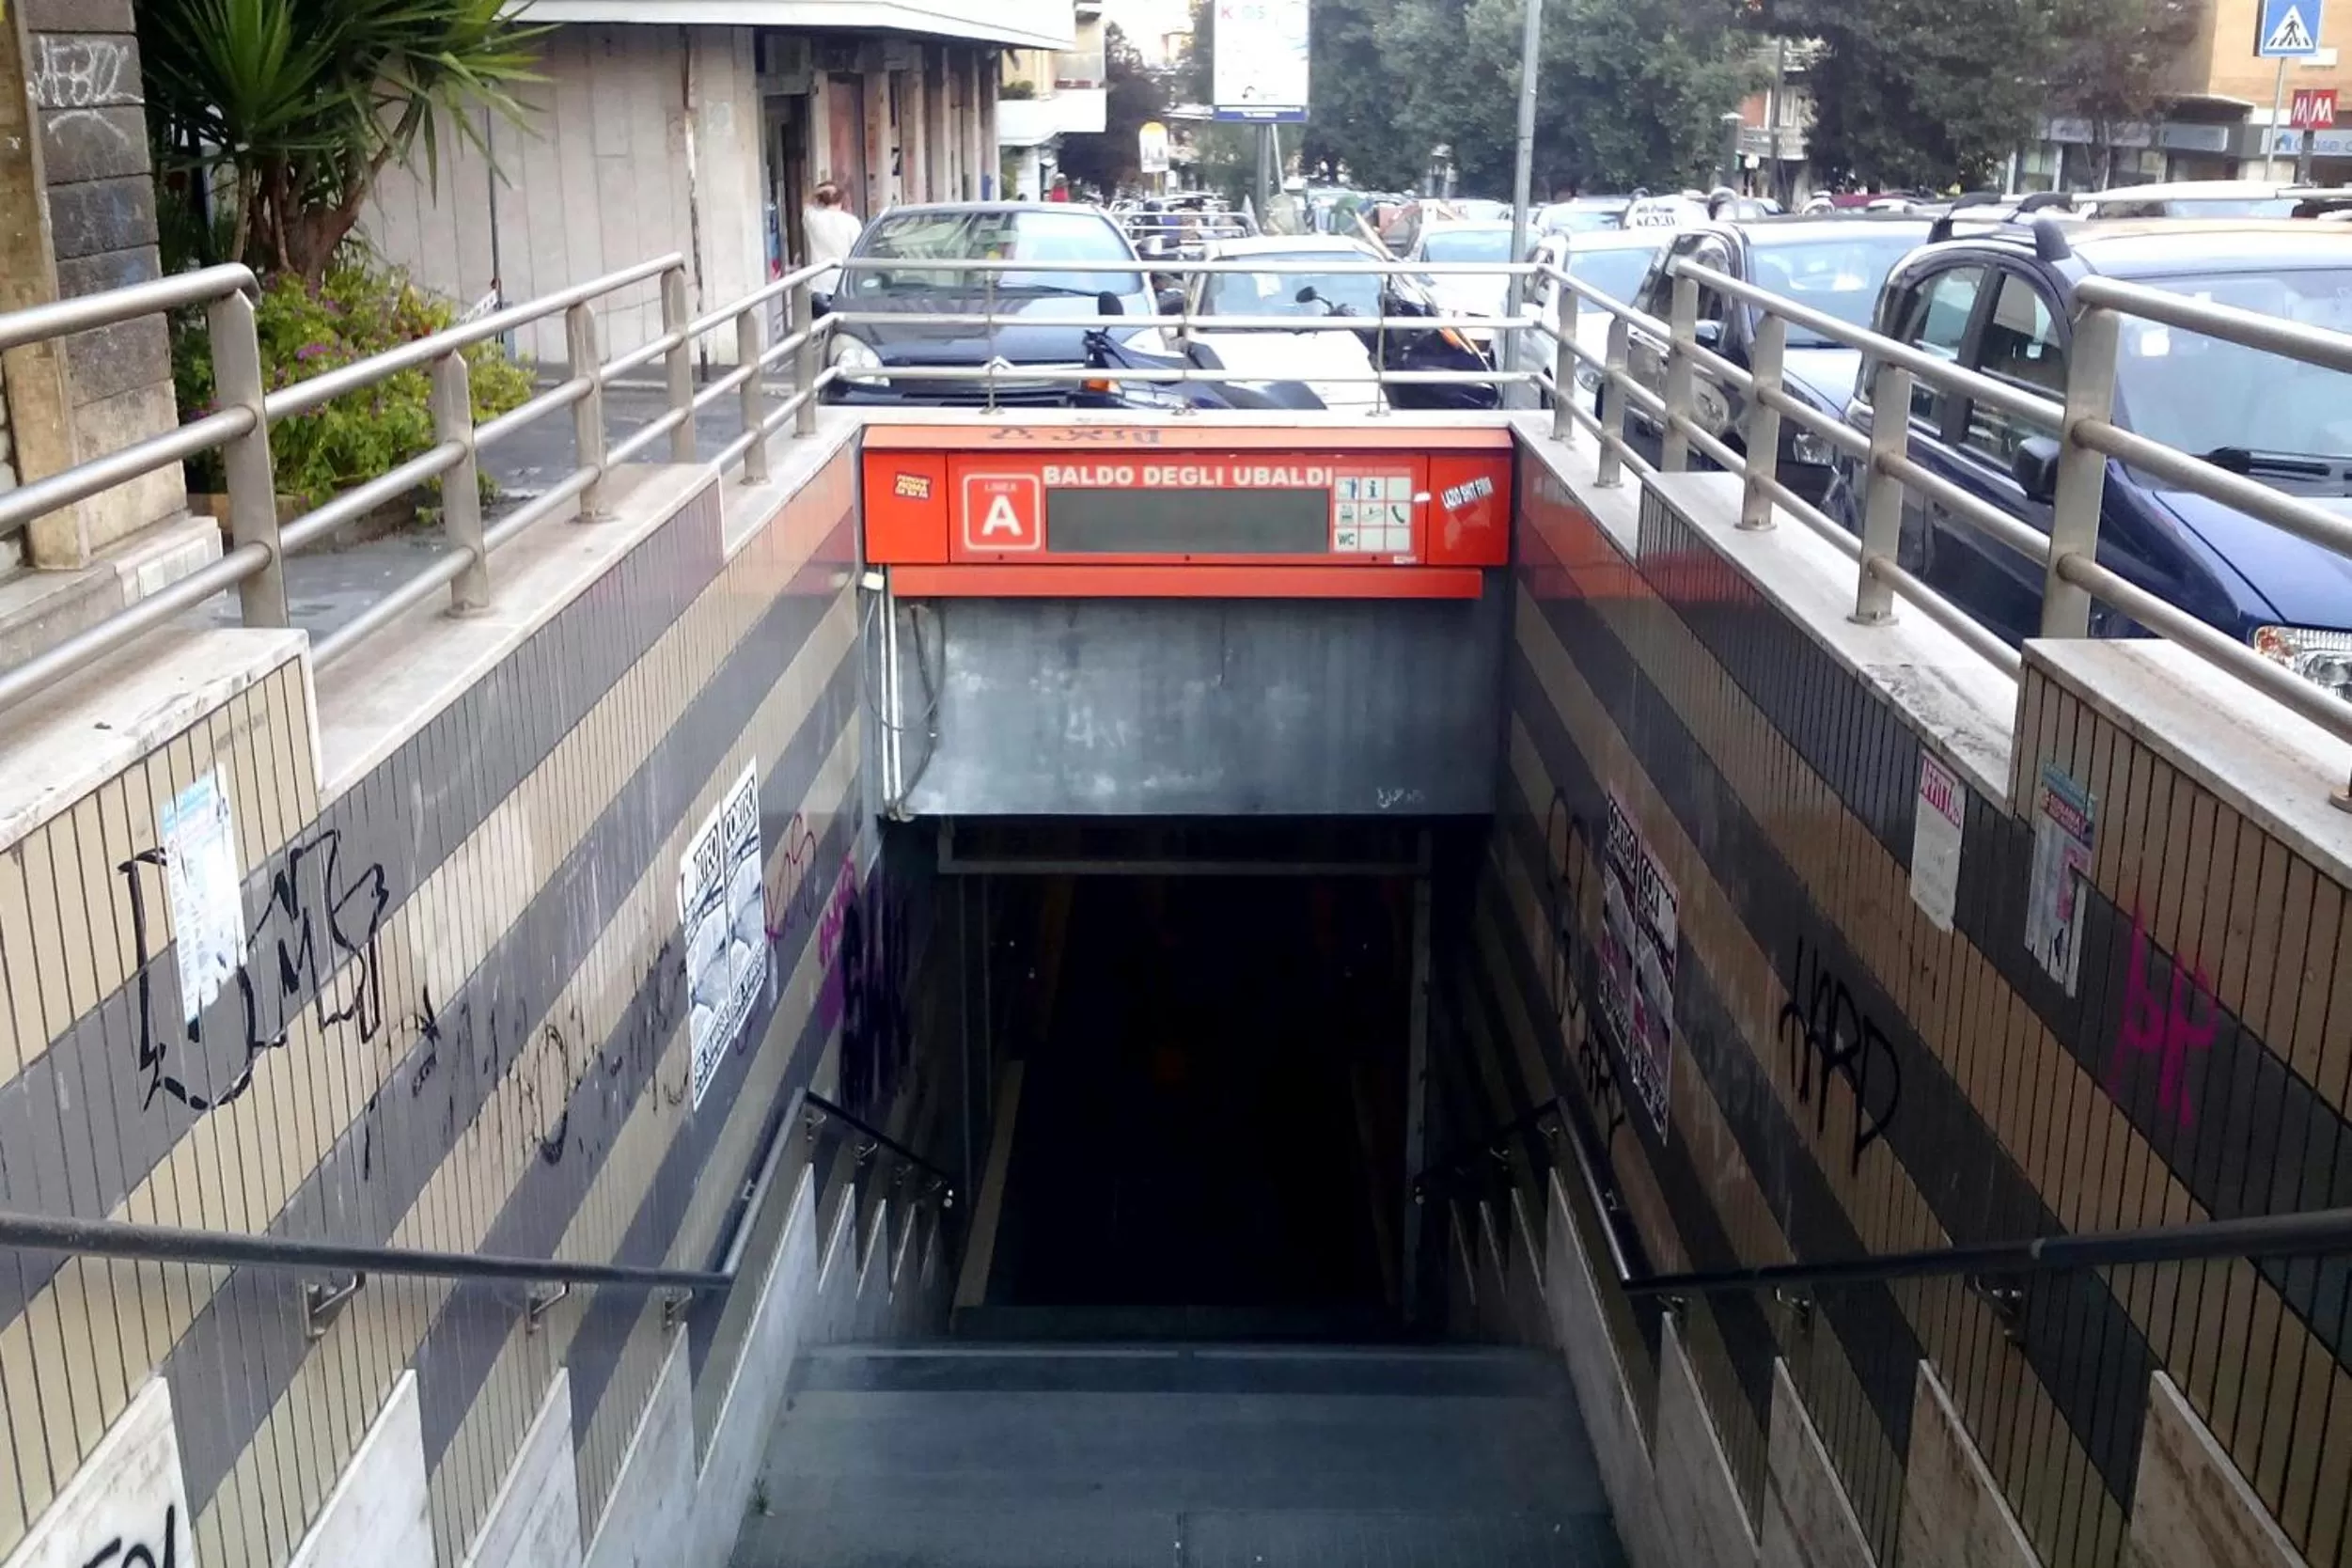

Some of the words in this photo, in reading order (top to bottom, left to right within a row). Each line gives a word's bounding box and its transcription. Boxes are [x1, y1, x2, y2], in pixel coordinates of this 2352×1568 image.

[2312, 97, 2333, 123] M
[1043, 465, 1135, 486] BALDO
[1142, 465, 1223, 486] DEGLI
[1232, 465, 1332, 486] UBALDI
[981, 494, 1023, 537] A
[1338, 533, 1356, 546] WC
